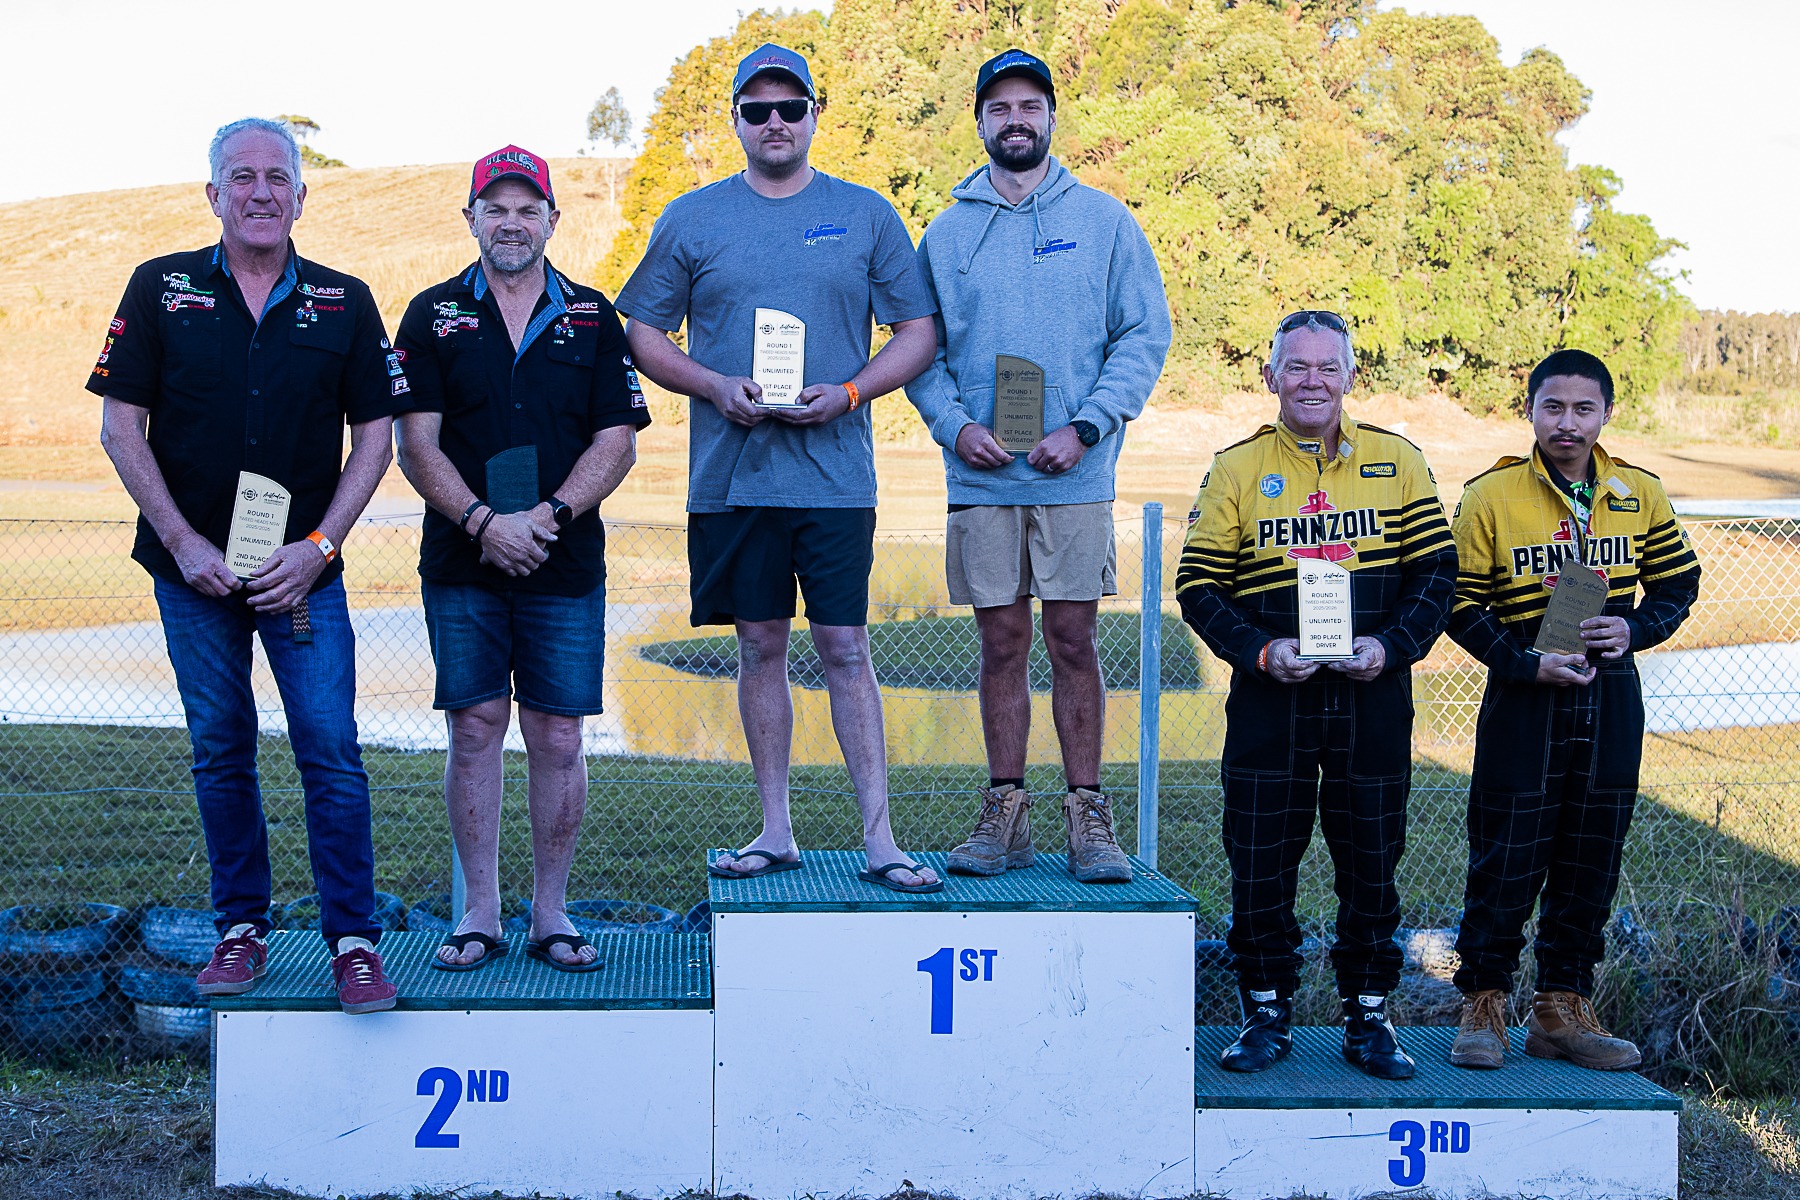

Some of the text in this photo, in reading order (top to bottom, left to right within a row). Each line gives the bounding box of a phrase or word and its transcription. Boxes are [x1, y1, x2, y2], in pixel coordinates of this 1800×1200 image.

[247, 510, 270, 518] ROUND
[240, 536, 272, 546] UNLIMITED
[1257, 508, 1384, 549] PENNZOIL
[1511, 536, 1636, 577] PENNZOIL
[1565, 595, 1587, 606] ROUND
[1554, 619, 1583, 632] UNLIMITED
[1560, 638, 1578, 647] PLACE
[917, 948, 998, 1034] 1ST
[415, 1067, 509, 1148] 2ND
[1388, 1120, 1470, 1187] 3RD
